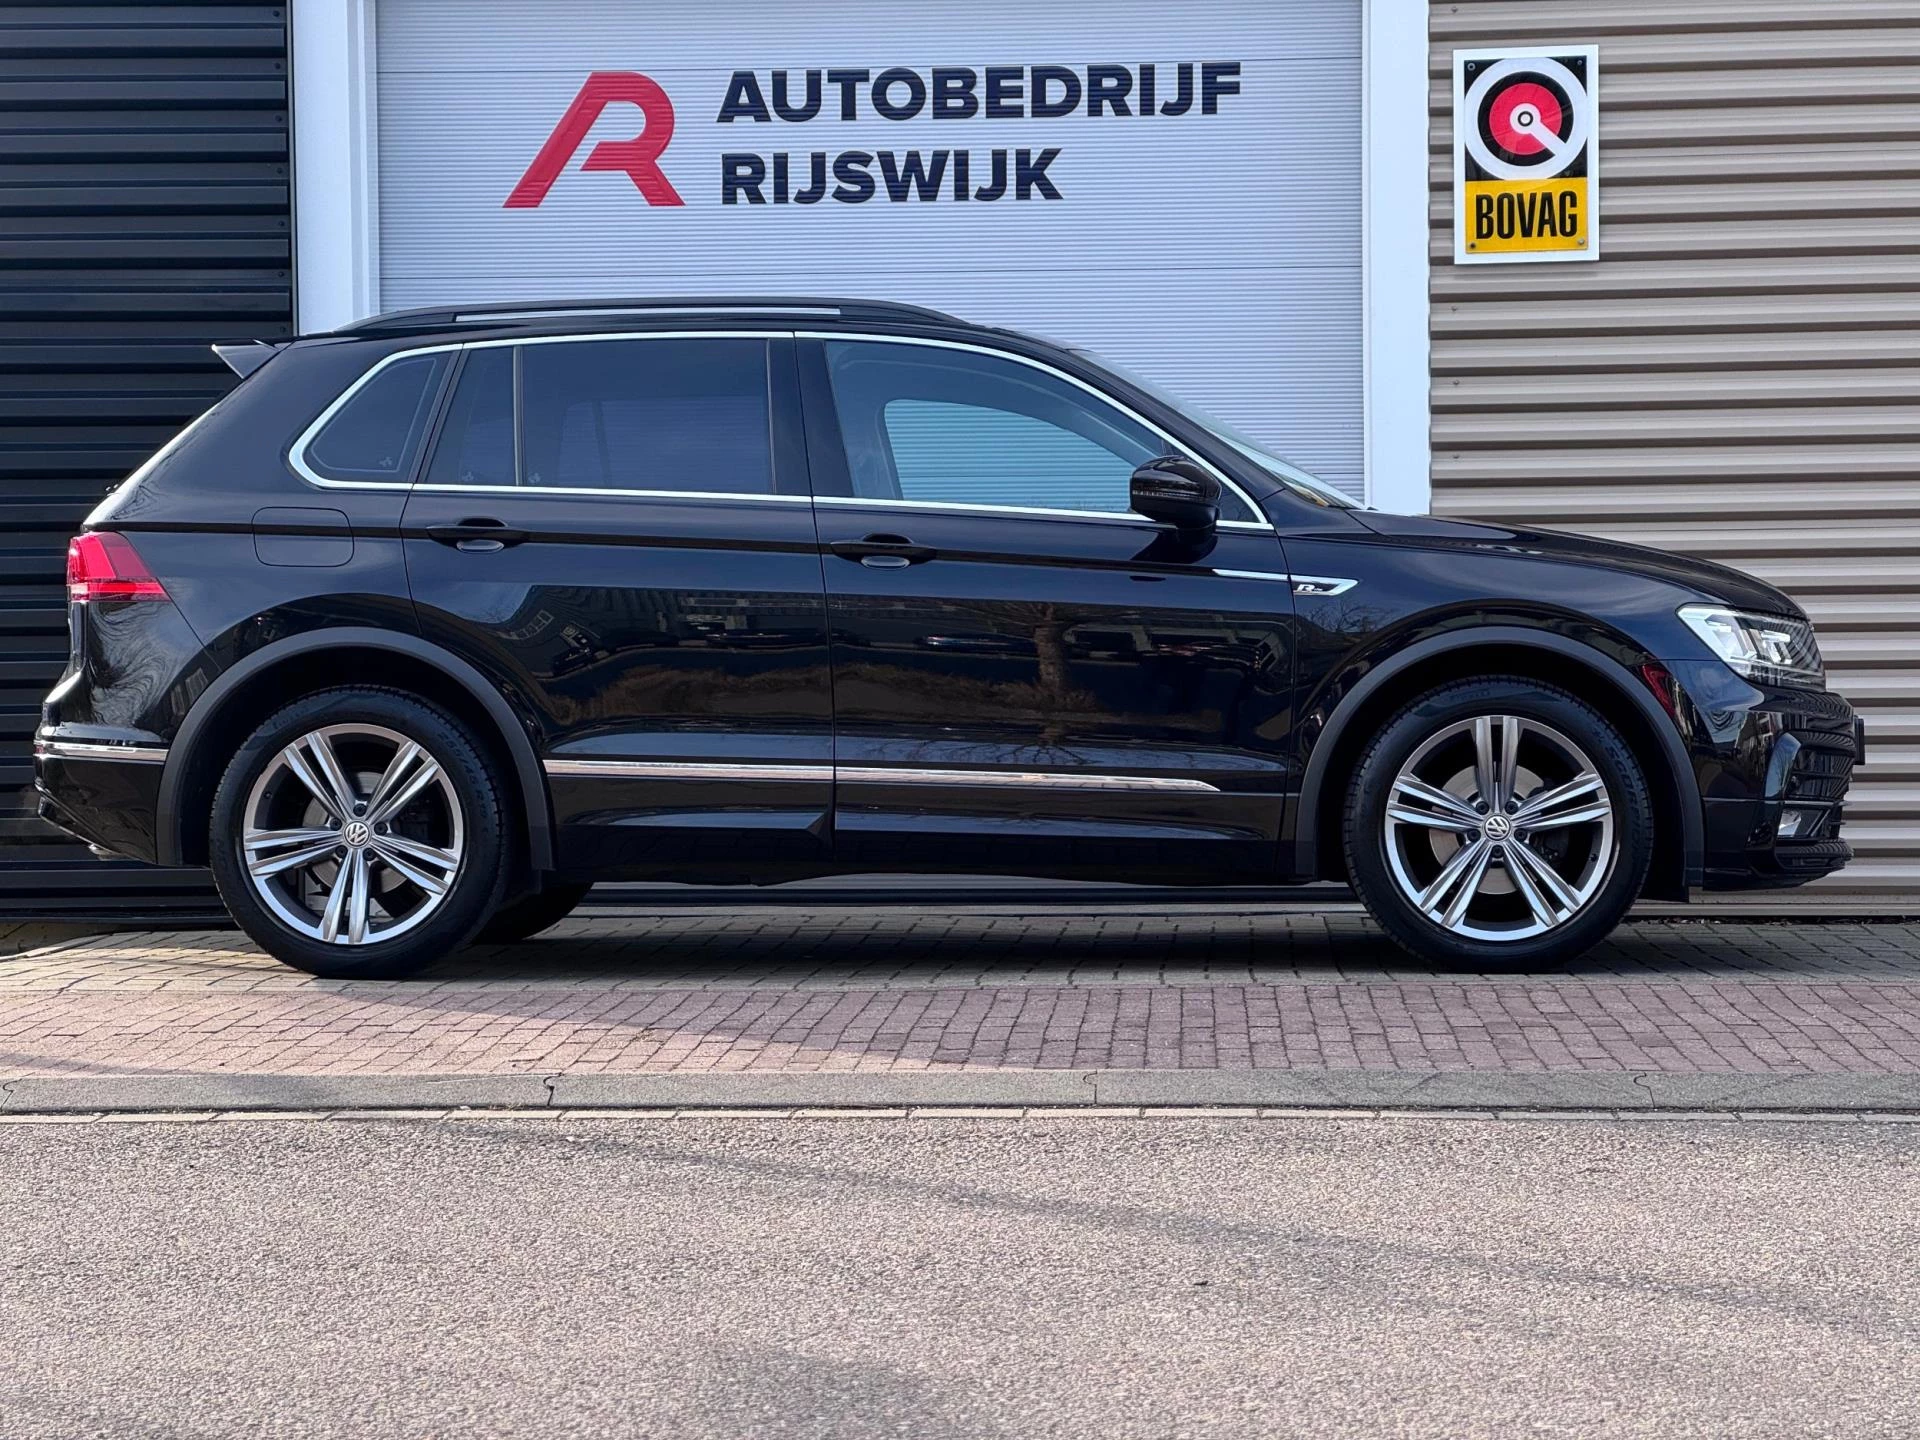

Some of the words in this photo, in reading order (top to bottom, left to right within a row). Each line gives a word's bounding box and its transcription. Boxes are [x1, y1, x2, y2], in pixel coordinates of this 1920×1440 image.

[716, 61, 1241, 123] AUTOBEDRIJF
[721, 147, 1064, 205] RIJSWIJK
[1475, 190, 1578, 240] BOVAG
